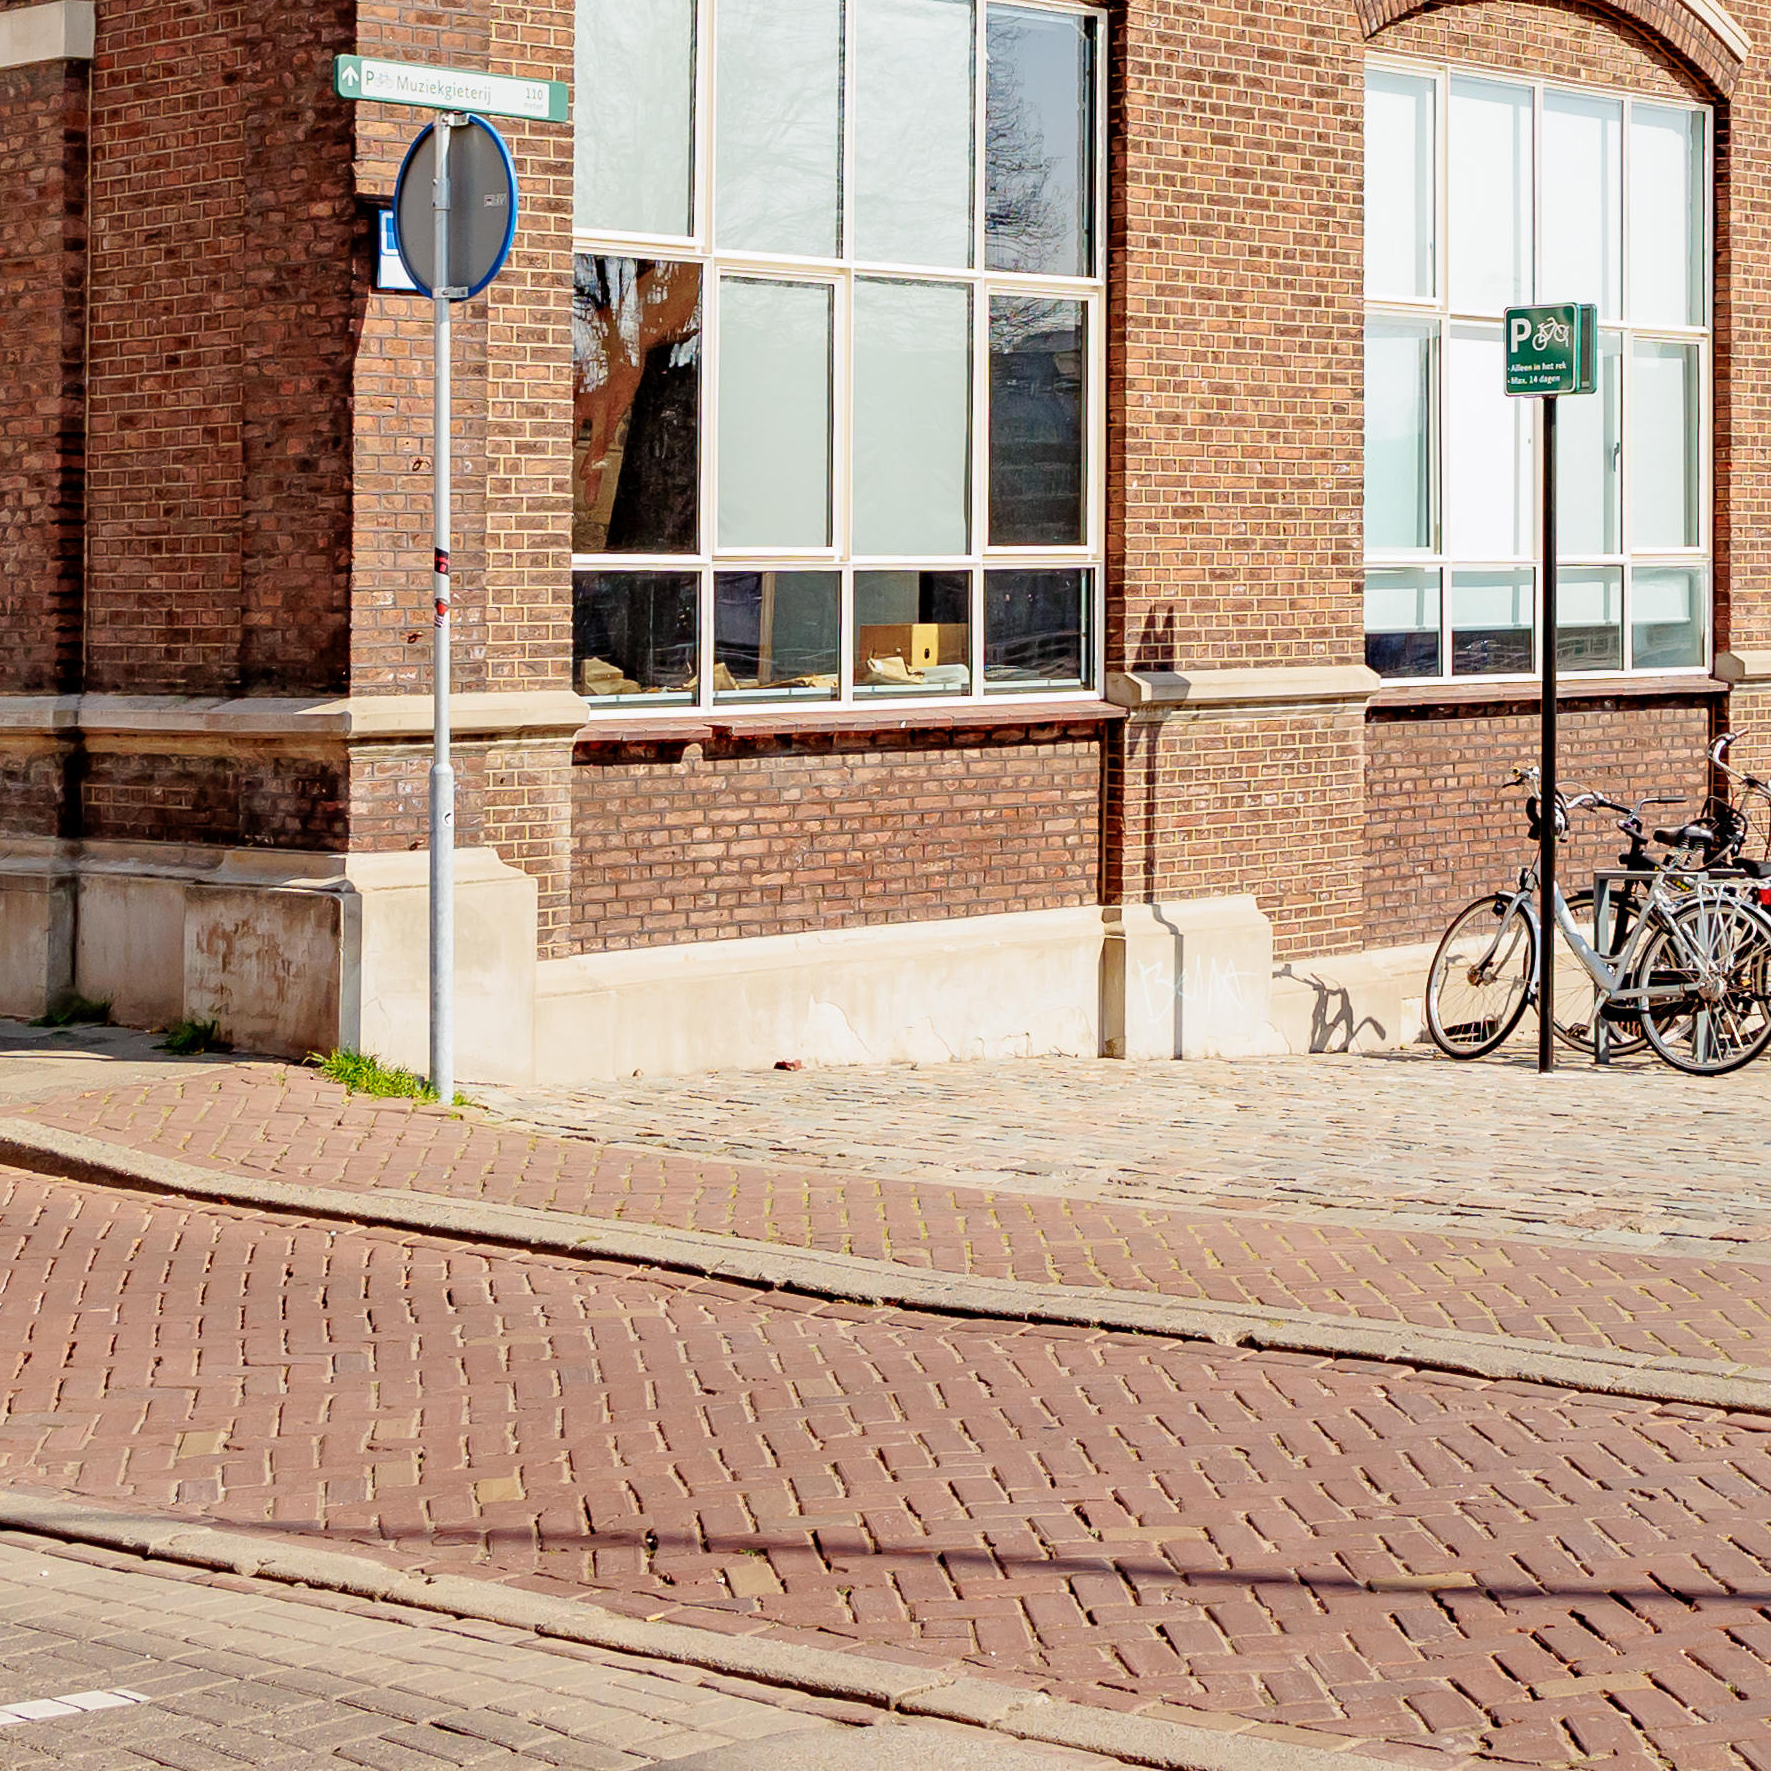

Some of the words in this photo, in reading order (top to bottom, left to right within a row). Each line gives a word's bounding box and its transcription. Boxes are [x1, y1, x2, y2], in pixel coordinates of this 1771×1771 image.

[396, 75, 492, 106] Muziekgieterij
[526, 87, 544, 101] 110
[1510, 317, 1532, 353] P
[1510, 363, 1533, 372] Alleen
[1533, 363, 1541, 371] in
[1541, 362, 1555, 370] het
[1555, 360, 1567, 370] rek
[1510, 376, 1528, 385] Max.
[1529, 375, 1539, 384] 14
[1539, 374, 1561, 385] dagen
